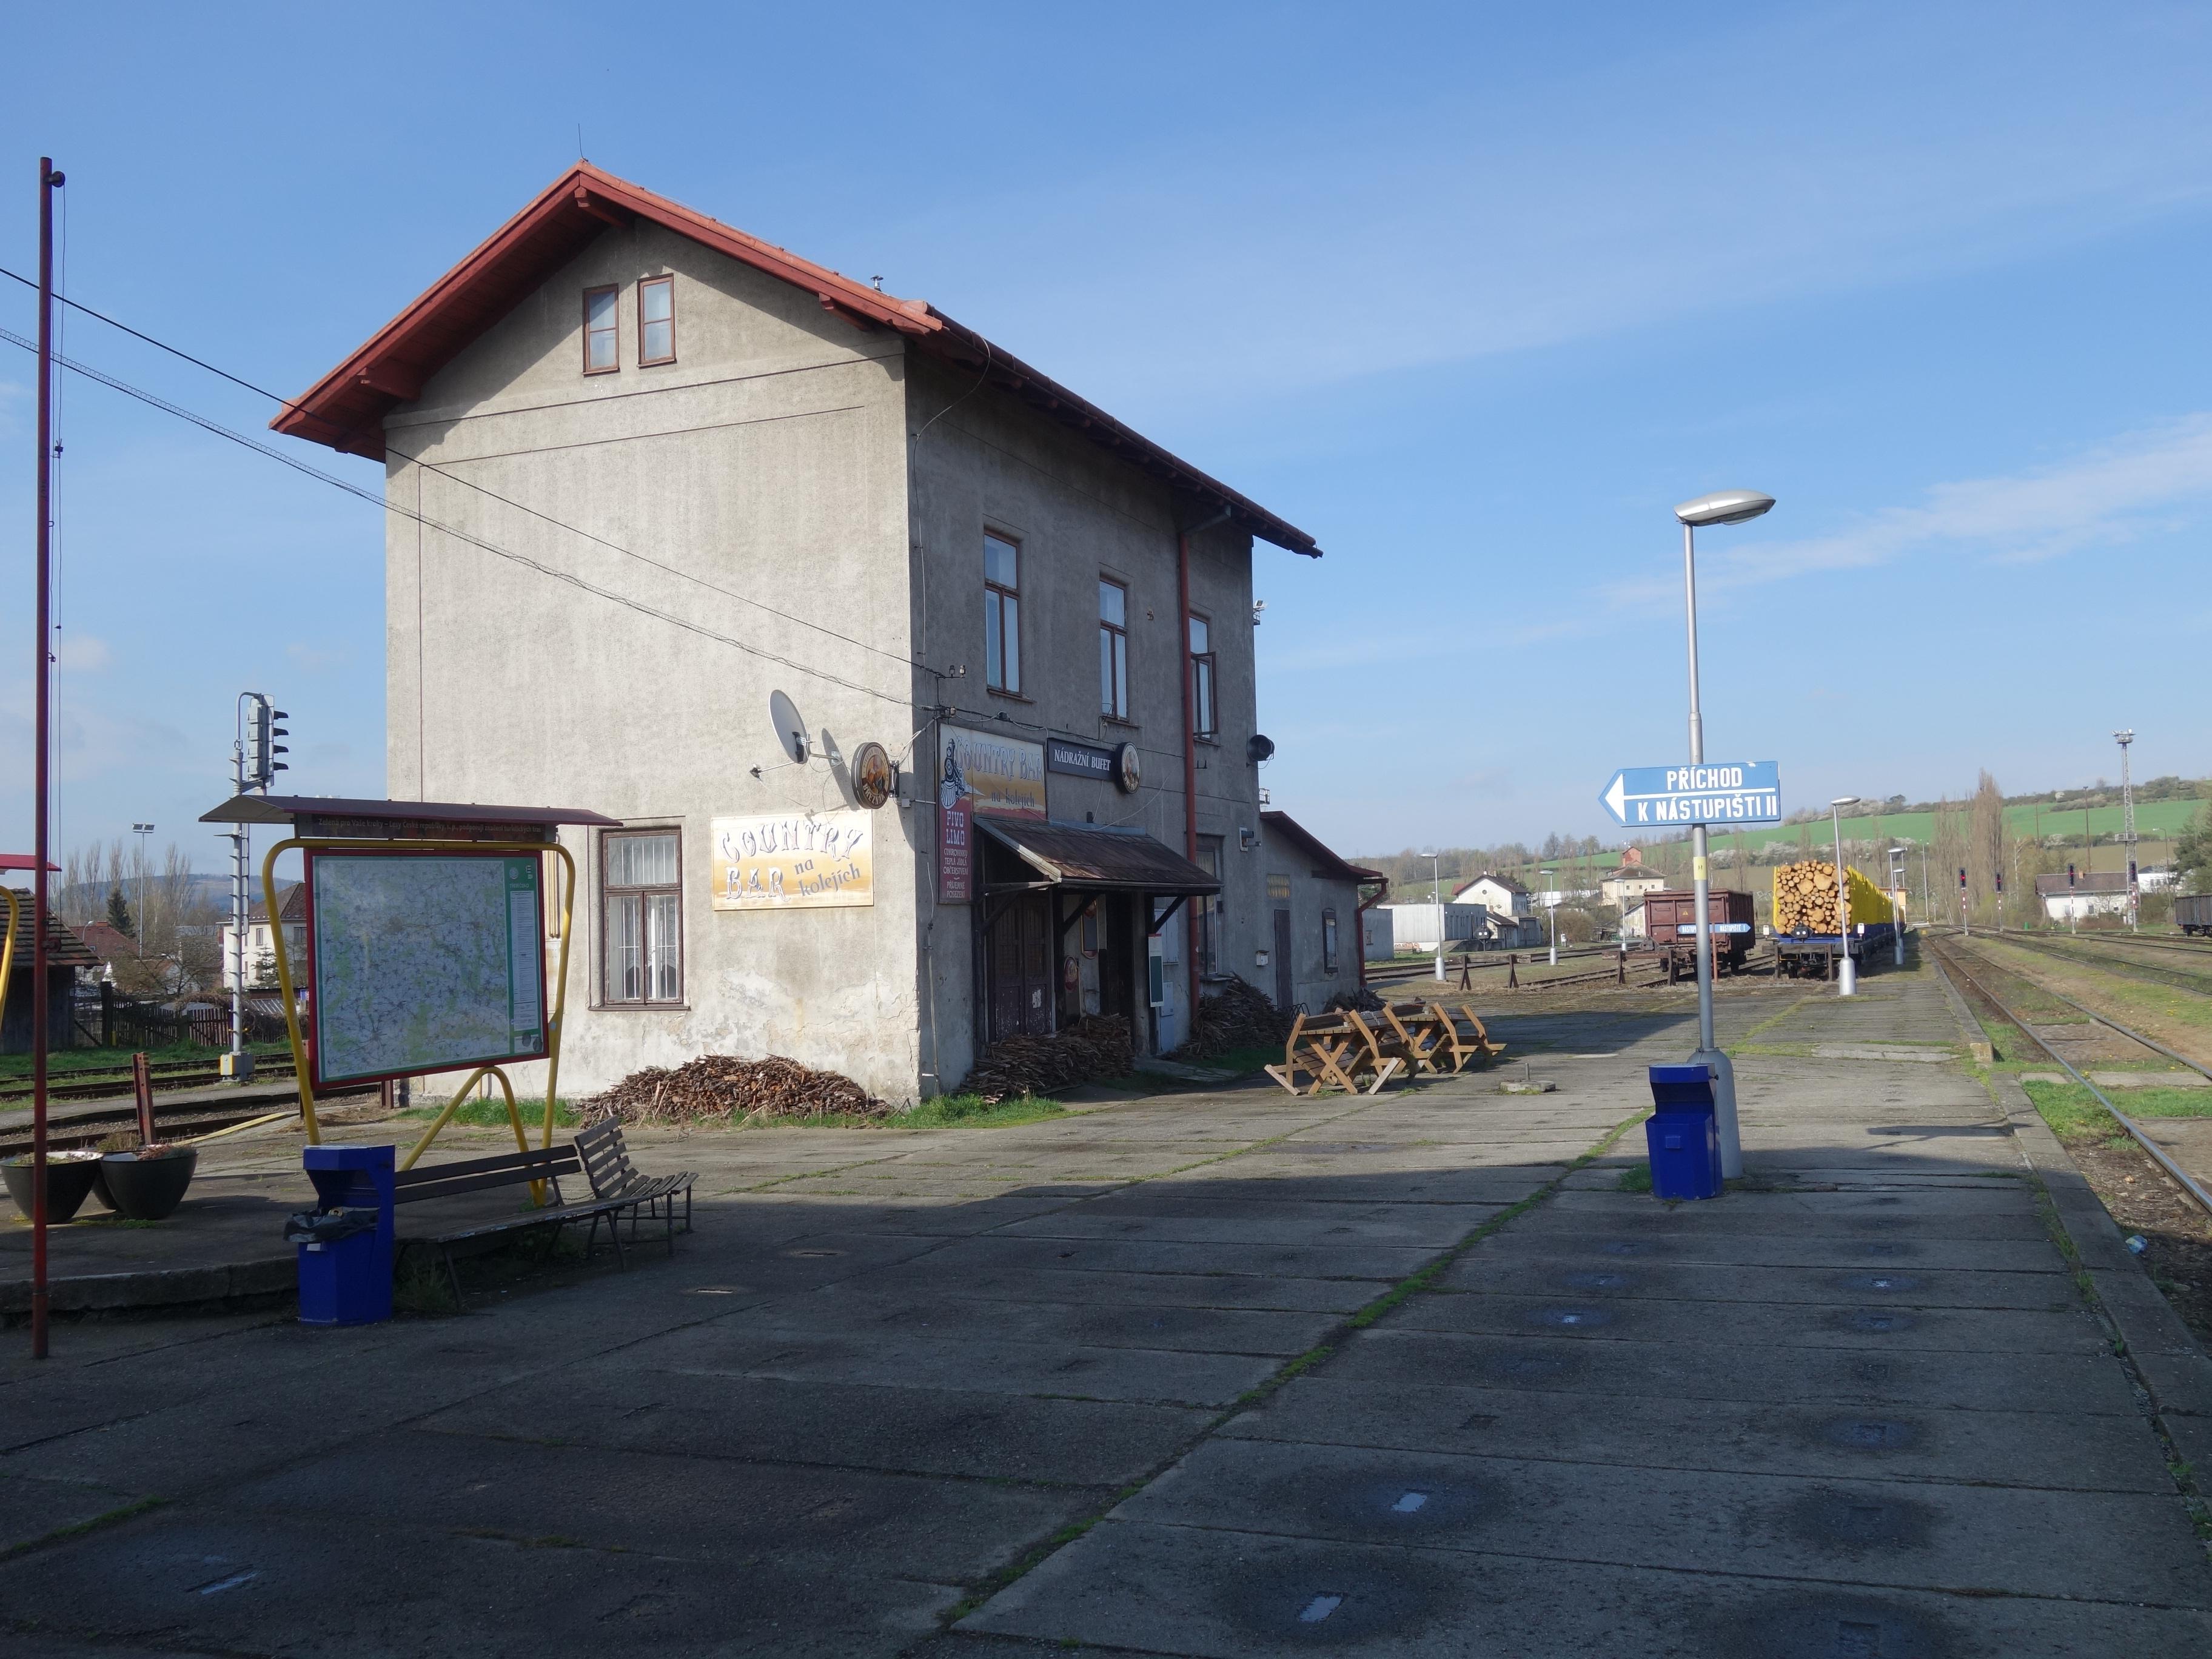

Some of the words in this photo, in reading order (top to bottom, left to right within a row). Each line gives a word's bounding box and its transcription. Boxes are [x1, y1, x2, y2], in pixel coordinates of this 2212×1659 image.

[955, 736, 1015, 781] COUNTRY
[1019, 748, 1043, 782] BAR
[1054, 747, 1089, 767] NÁDRAŽNÍ
[1091, 756, 1111, 771] BUFET
[1667, 765, 1743, 791] PŘÍCHOD
[991, 792, 1000, 802] na
[1637, 802, 1649, 821] K
[1656, 793, 1761, 821] NÁSTUPIŠTI
[1766, 795, 1777, 816] II
[366, 820, 383, 829] kroky
[947, 810, 964, 828] PIVO
[720, 819, 863, 863] COUNTRY
[946, 828, 965, 846] LIMO
[943, 848, 968, 859] CUKROVINKY
[794, 858, 814, 875] na
[726, 866, 791, 902] BAR
[798, 863, 861, 896] kolejích
